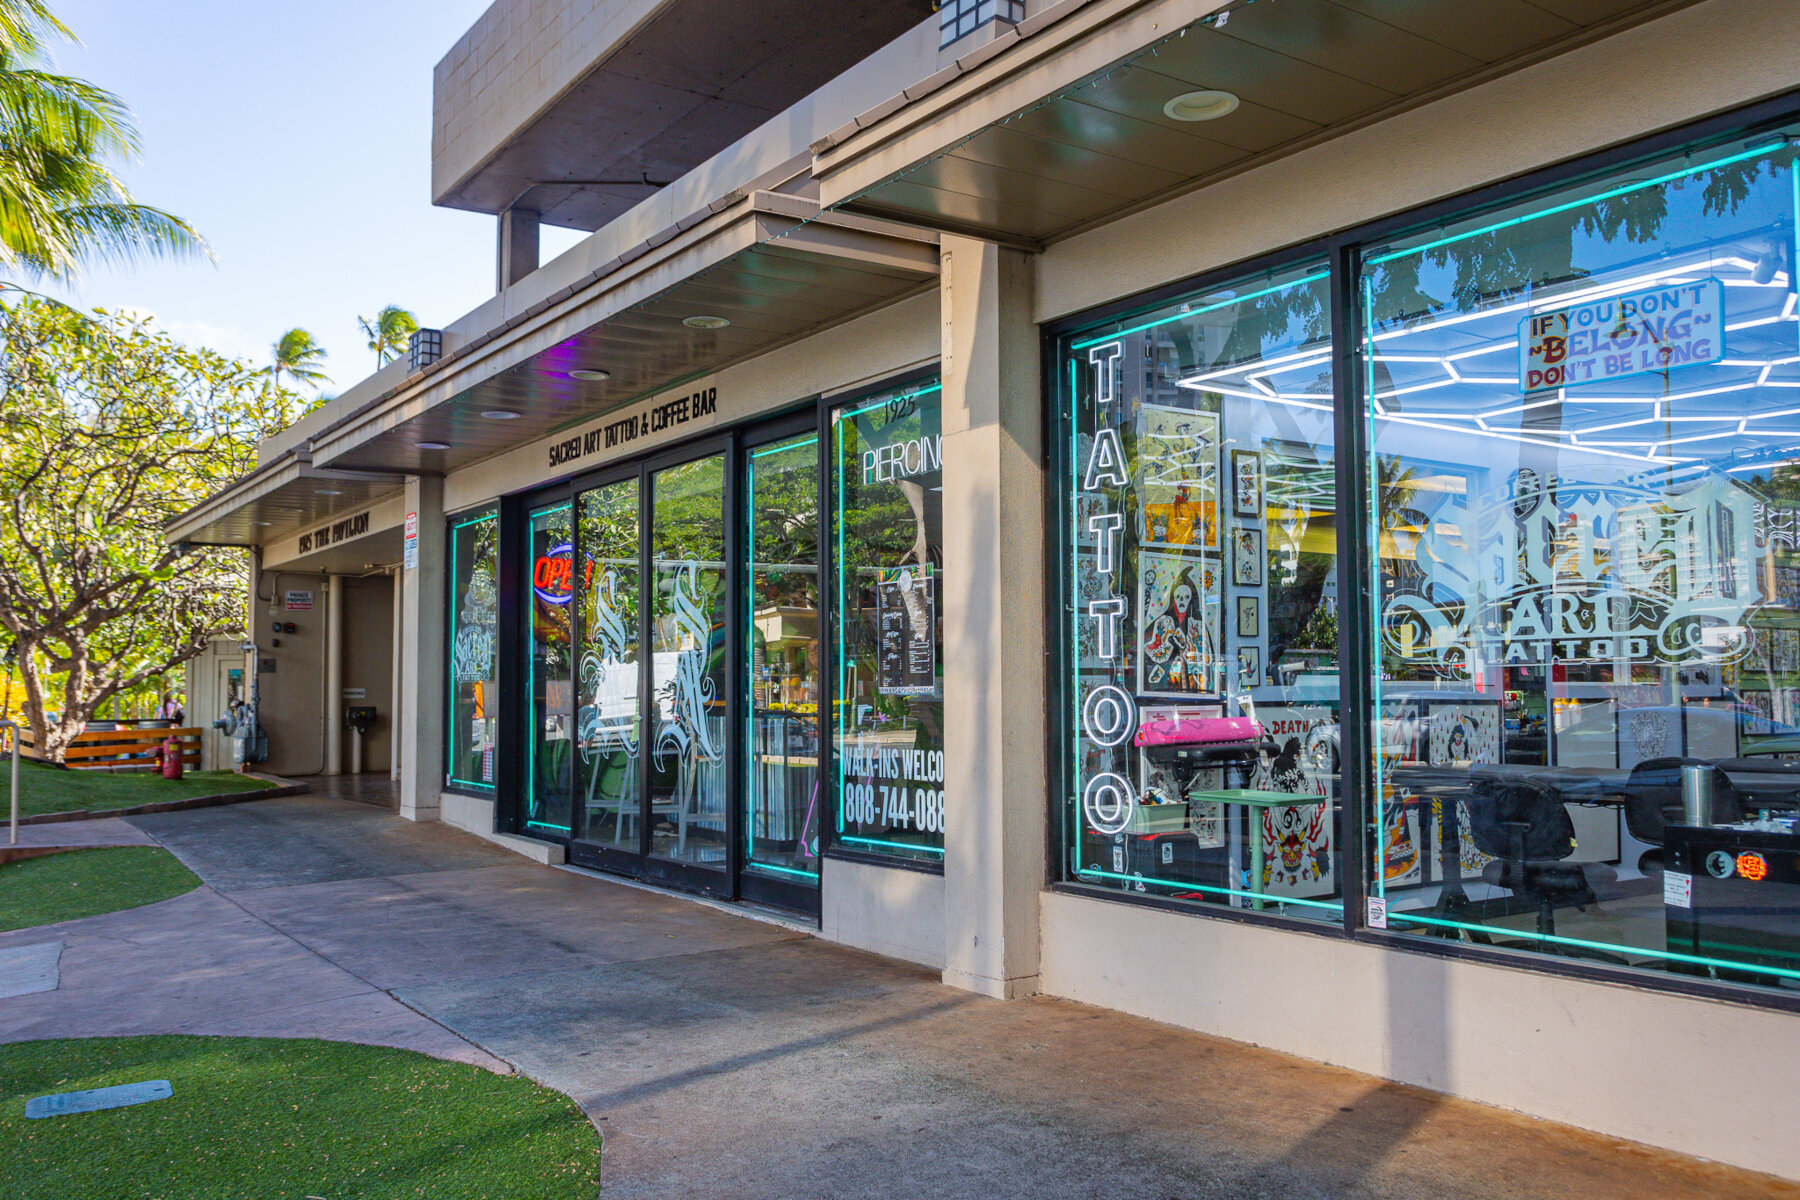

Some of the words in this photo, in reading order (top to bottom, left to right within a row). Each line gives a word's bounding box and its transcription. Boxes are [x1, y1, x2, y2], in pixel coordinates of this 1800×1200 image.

[1530, 313, 1554, 338] IF
[1555, 302, 1613, 333] YOU
[1619, 284, 1707, 322] DON'T
[1527, 358, 1596, 390] DON'T
[1604, 350, 1634, 376] BE
[1641, 338, 1712, 371] LONG
[549, 436, 581, 467] SACRED
[583, 428, 602, 456] ART
[604, 416, 639, 449] TATTOO
[640, 412, 648, 436] &
[651, 396, 690, 432] COFFEE
[692, 387, 717, 419] BAR
[885, 394, 916, 425] 1925
[863, 433, 943, 486] PIERCIN
[1590, 468, 1650, 489] BAR
[314, 526, 330, 549] THE
[332, 511, 370, 543] PAVILION
[533, 556, 593, 591] OPE
[1083, 340, 1133, 834] TATTOO
[1500, 593, 1656, 638] ART
[1483, 638, 1649, 662] TATTOO
[1272, 720, 1309, 735] DEATH
[844, 746, 899, 779] WALK-INS
